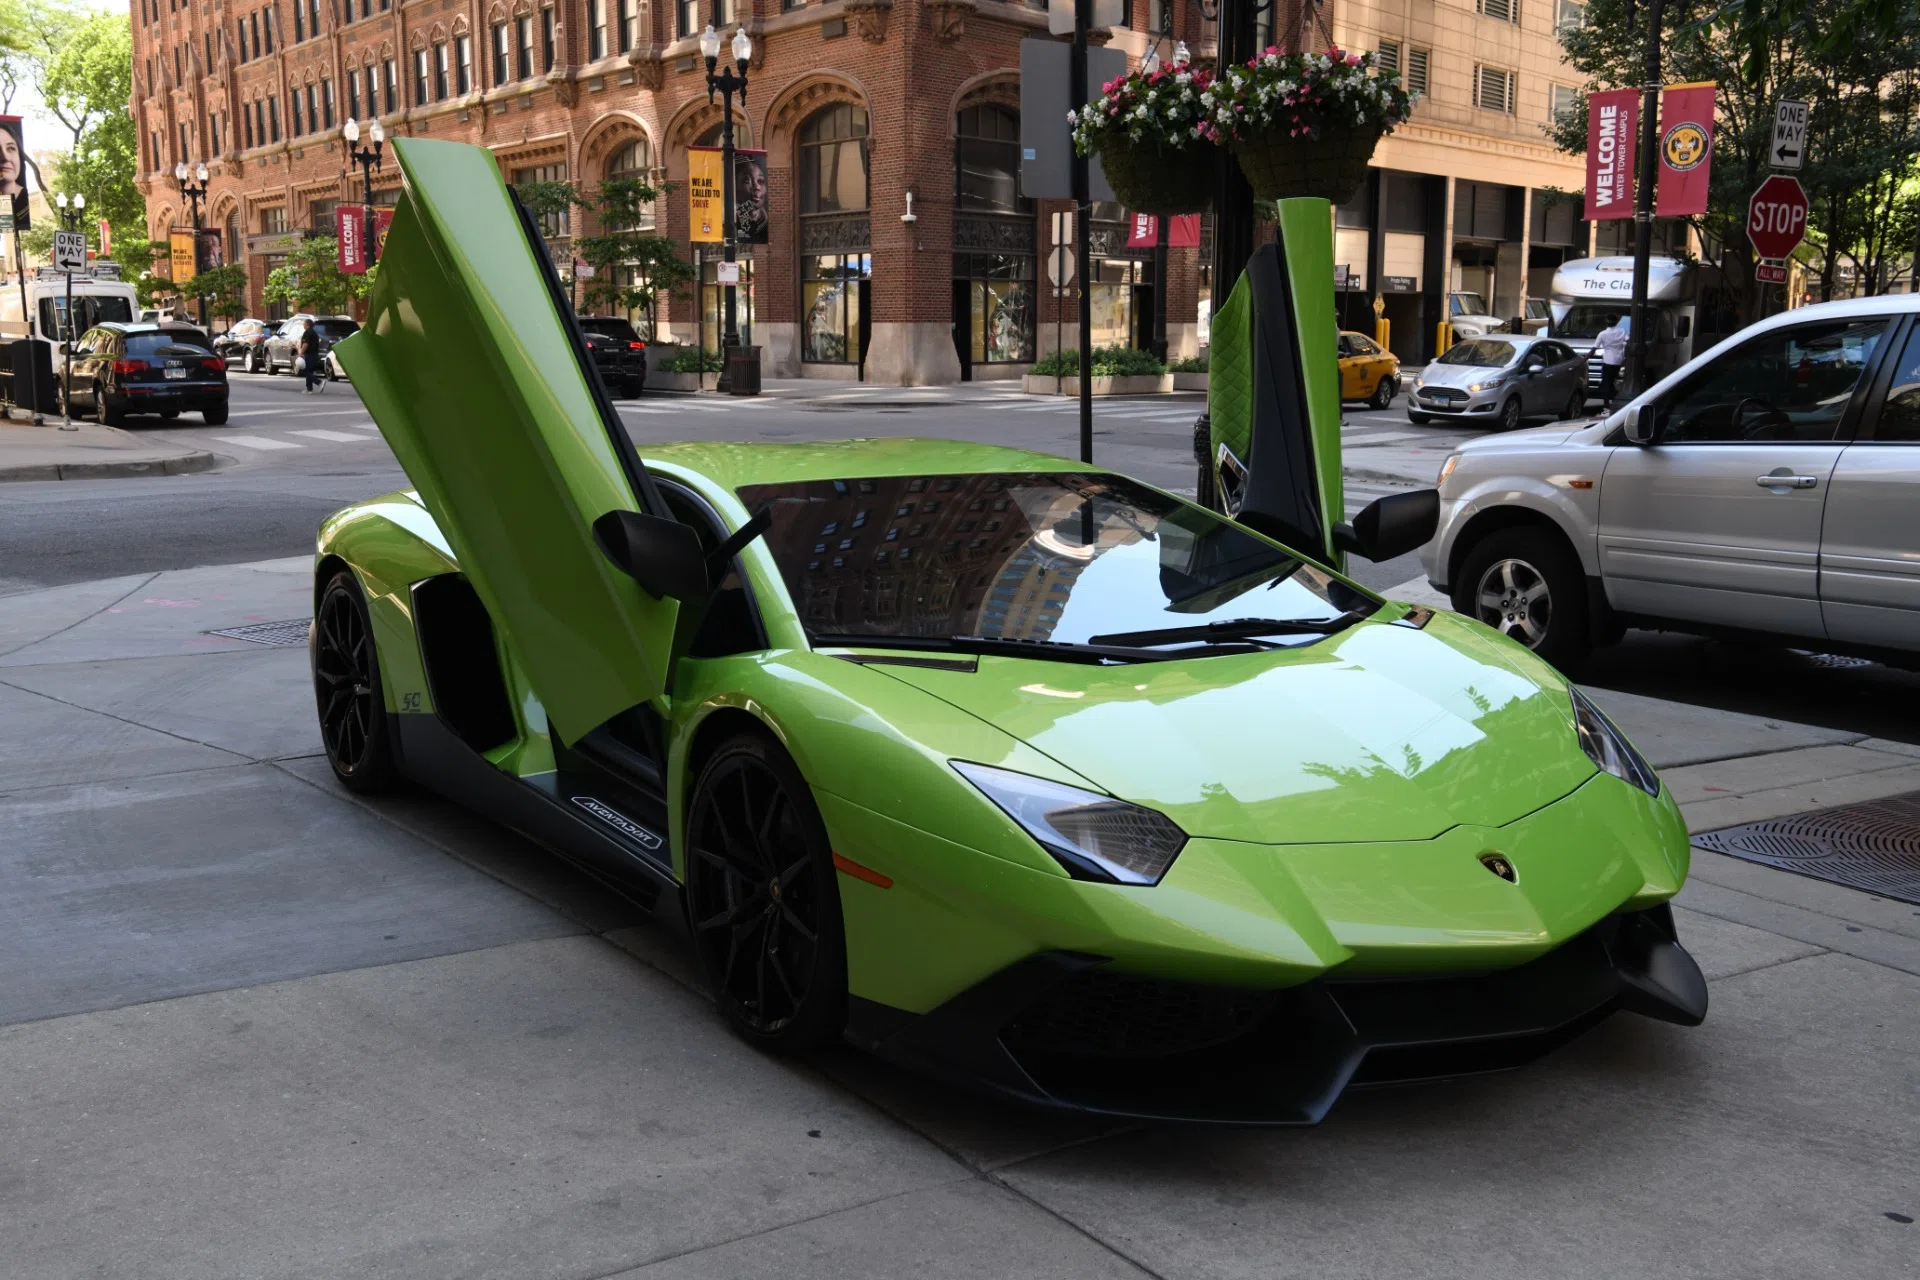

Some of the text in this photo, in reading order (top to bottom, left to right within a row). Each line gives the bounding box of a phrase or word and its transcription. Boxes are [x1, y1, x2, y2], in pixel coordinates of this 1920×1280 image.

[1779, 105, 1805, 124] ONE
[1777, 125, 1803, 142] WAY
[1596, 105, 1617, 207] WELCOME
[1616, 110, 1628, 200] WATER TOWER CAMPUS
[692, 177, 712, 187] WE ARE
[692, 188, 720, 198] CALLED TO
[692, 199, 709, 208] SOLVE
[1752, 201, 1805, 235] STOP
[58, 235, 82, 246] ONE
[343, 214, 354, 266] WELCOME
[58, 246, 82, 257] WAY
[1759, 268, 1786, 280] ALL WAY
[1583, 279, 1634, 290] The Cla
[583, 802, 653, 841] AVENTADOR
